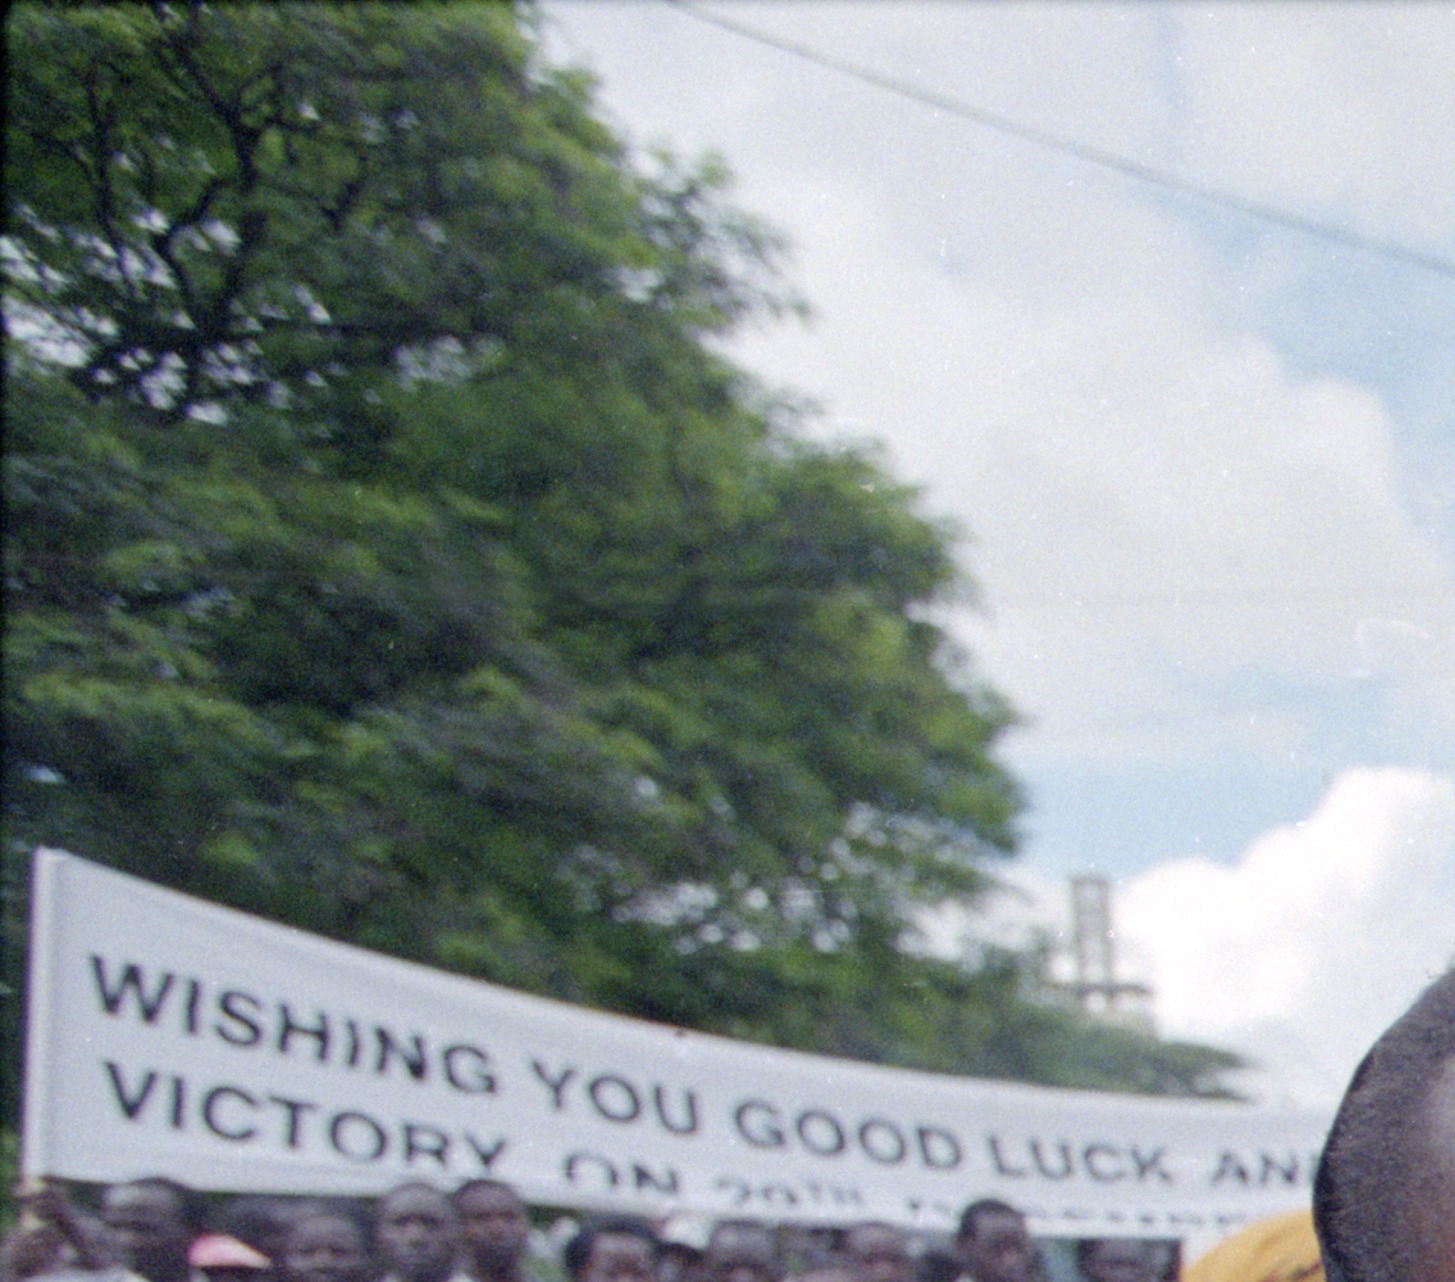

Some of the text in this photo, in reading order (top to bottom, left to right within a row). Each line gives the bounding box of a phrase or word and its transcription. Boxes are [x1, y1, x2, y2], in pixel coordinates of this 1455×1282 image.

[90, 952, 498, 1095] WISHING
[531, 1060, 698, 1136] YOU
[733, 1098, 963, 1170] GOOD
[990, 1134, 1173, 1184] LUCK
[103, 1060, 507, 1170] VICTORY
